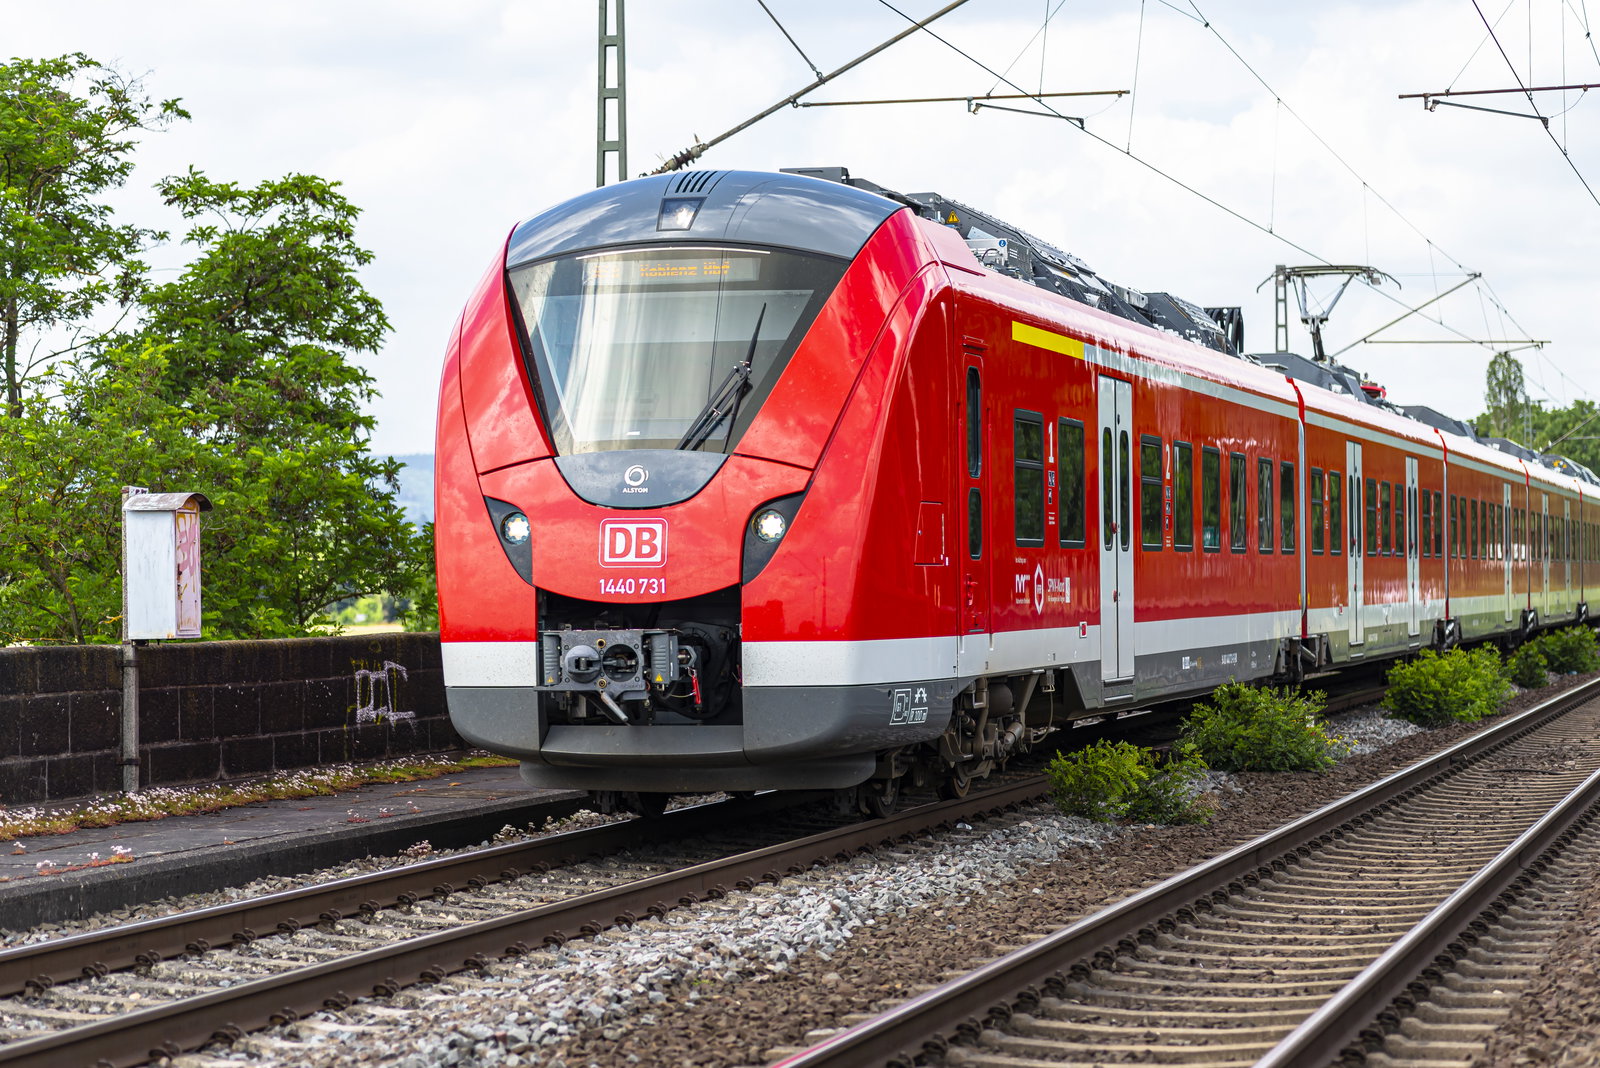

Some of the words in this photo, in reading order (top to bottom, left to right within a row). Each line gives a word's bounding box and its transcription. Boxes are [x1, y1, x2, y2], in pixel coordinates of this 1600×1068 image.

[608, 527, 659, 559] DB
[599, 578, 636, 595] 1440
[638, 577, 667, 594] 731
